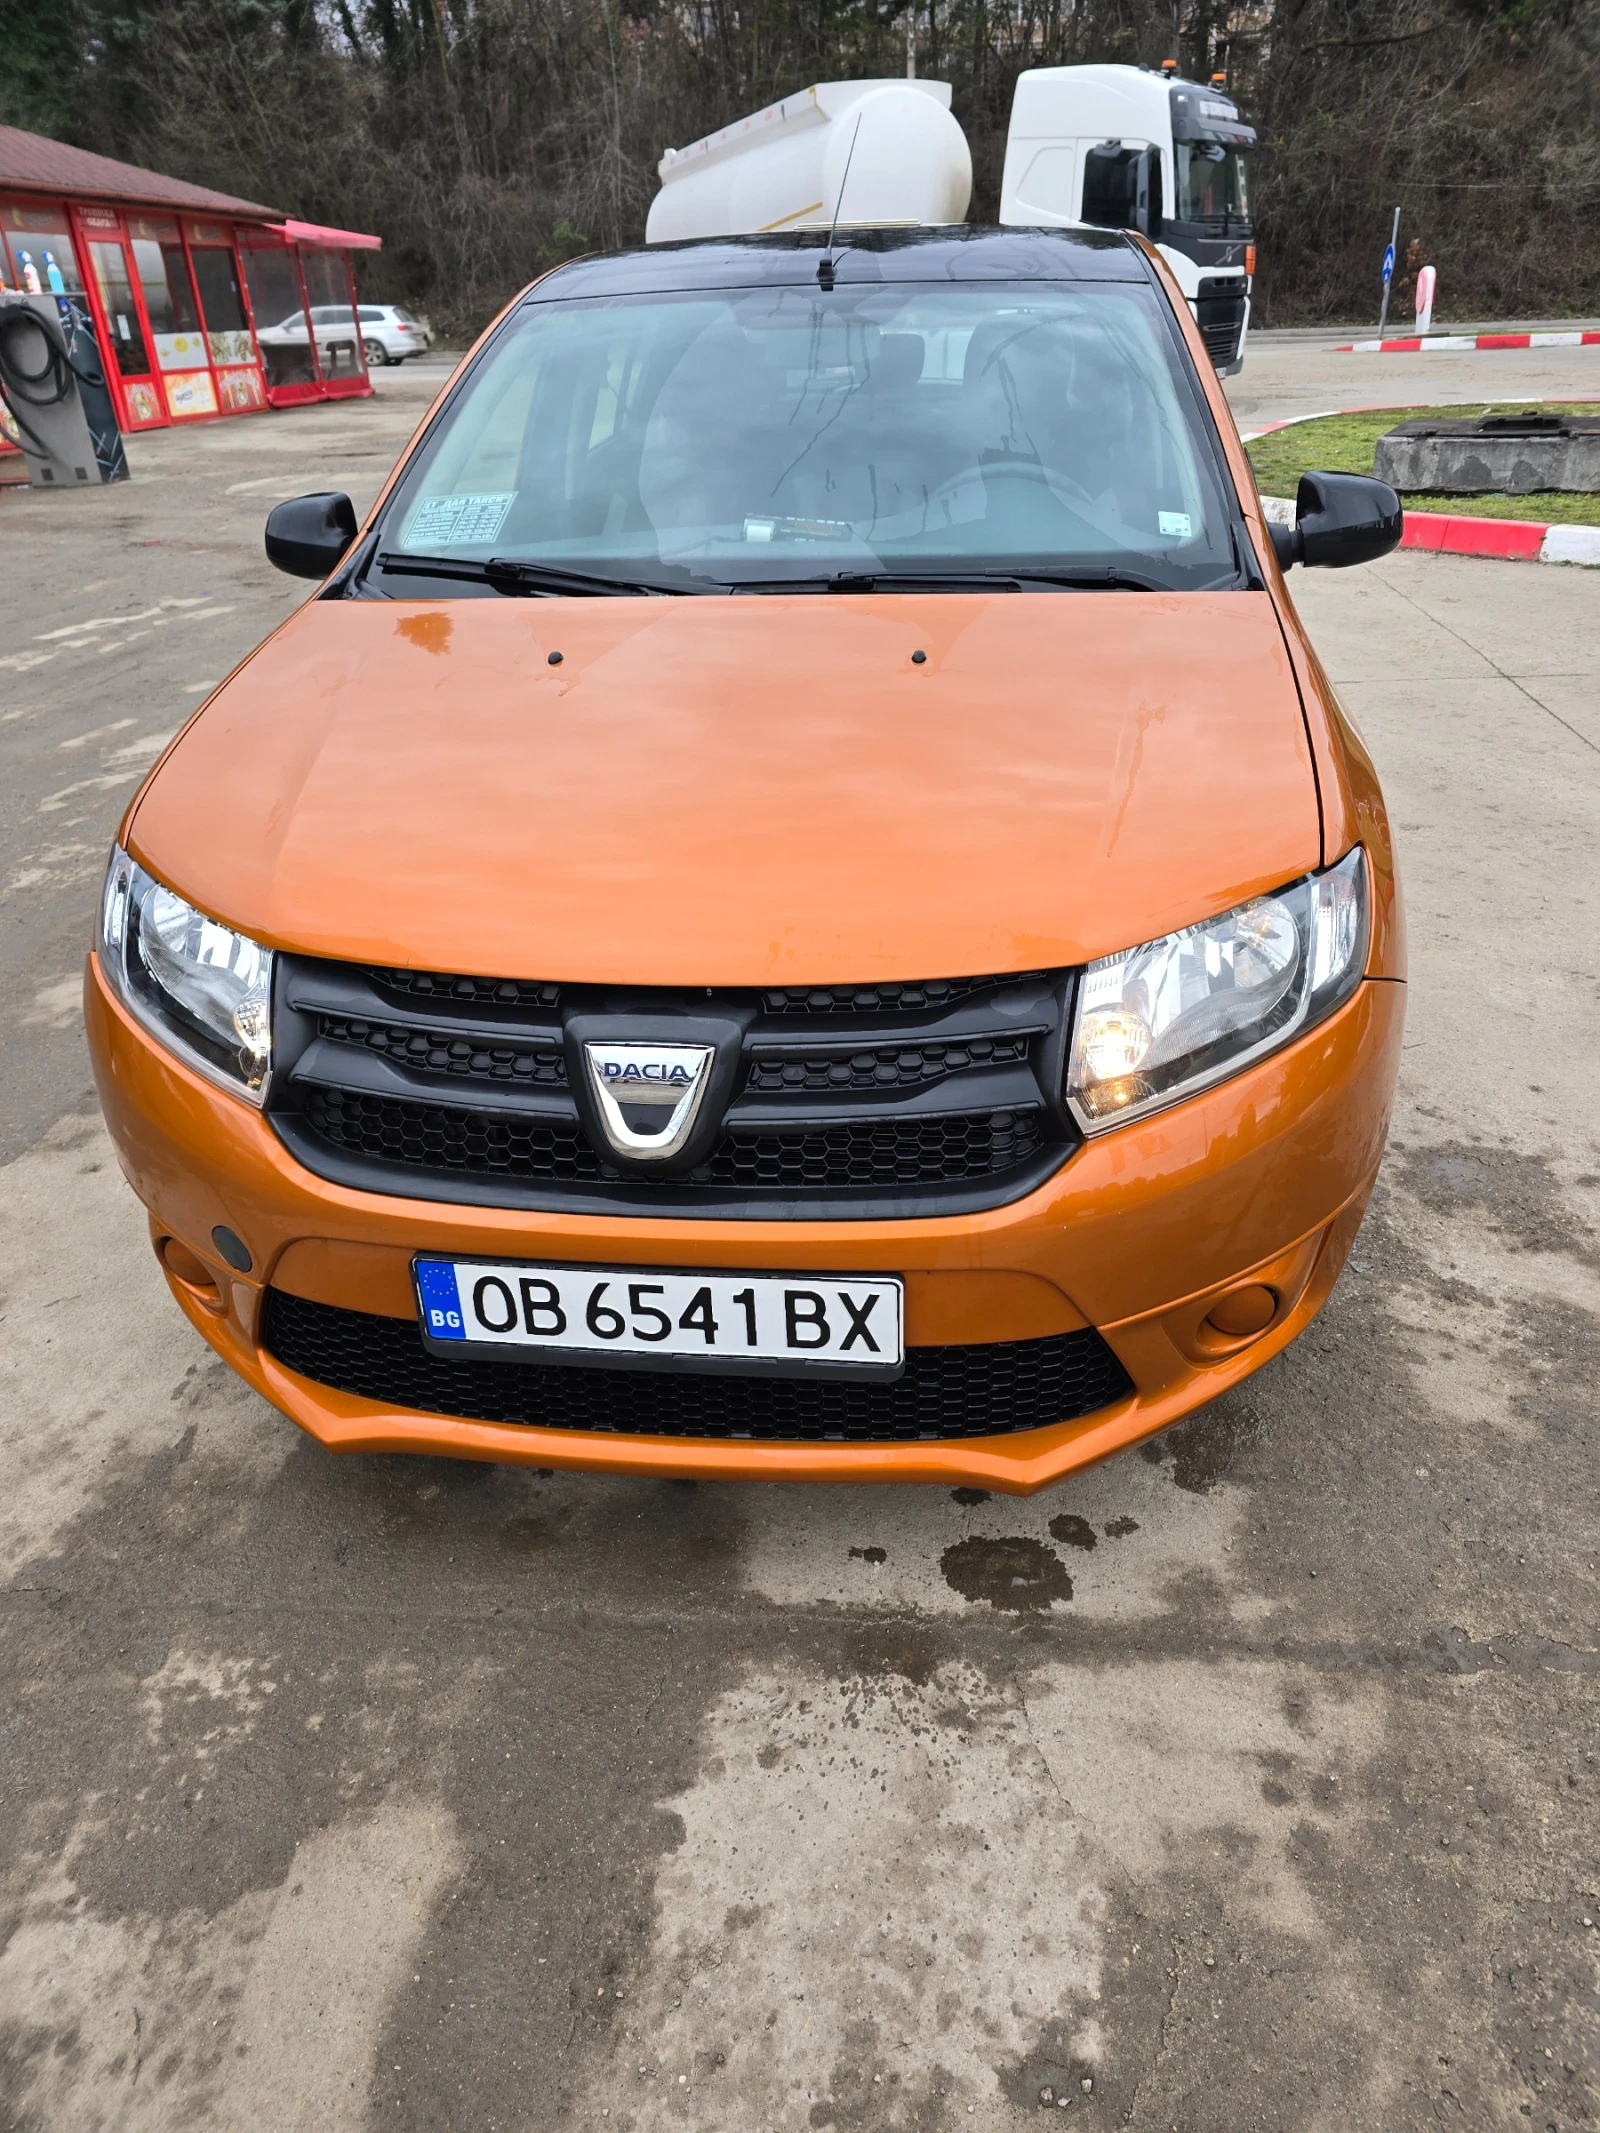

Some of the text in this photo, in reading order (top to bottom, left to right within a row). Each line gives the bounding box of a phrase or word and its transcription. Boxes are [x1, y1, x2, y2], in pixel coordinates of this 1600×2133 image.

[603, 1062, 690, 1082] DACIA
[430, 1308, 461, 1328] BG
[473, 1275, 881, 1353] OB 6541 BX
